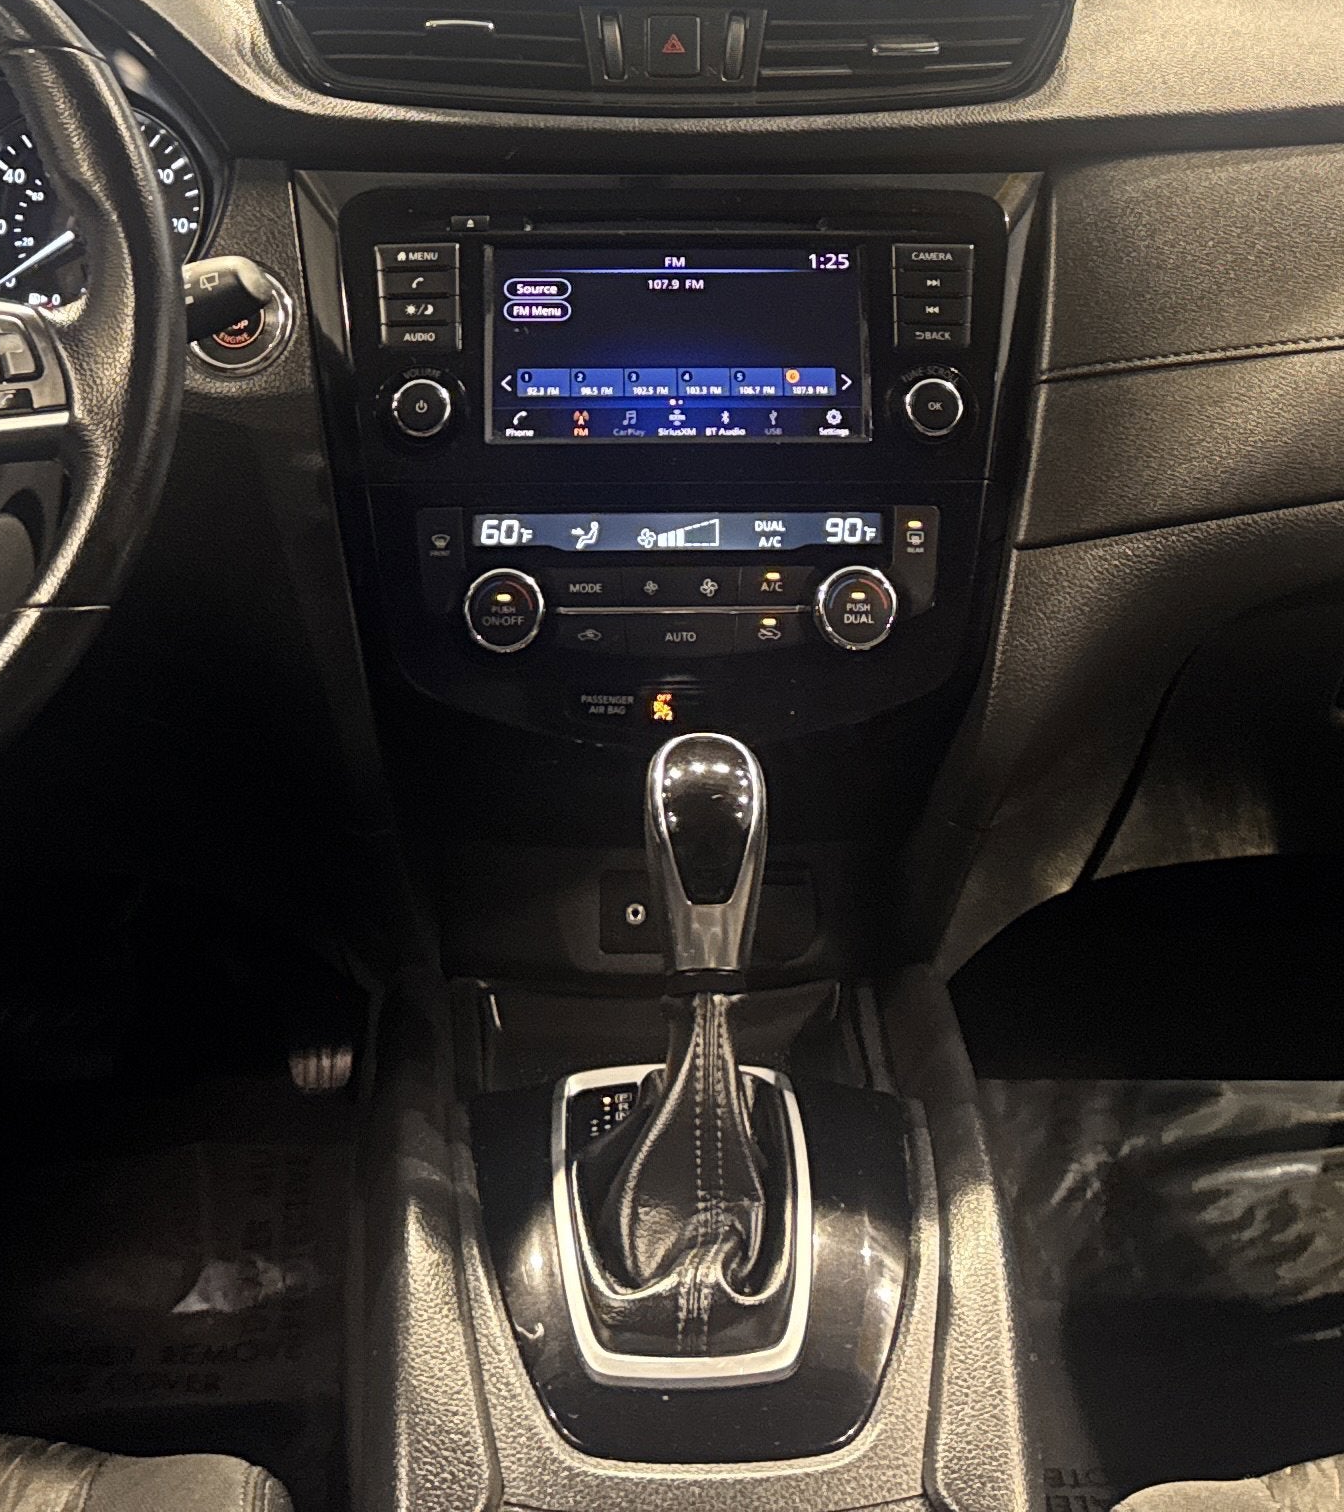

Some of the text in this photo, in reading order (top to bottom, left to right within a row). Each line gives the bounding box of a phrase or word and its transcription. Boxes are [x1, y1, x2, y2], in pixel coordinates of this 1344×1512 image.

[2, 167, 27, 184] 40
[408, 252, 439, 262] MENU
[808, 253, 850, 270] 1:25
[911, 252, 953, 261] CAMERA
[664, 256, 686, 268] FM
[516, 283, 558, 295] Source
[647, 279, 705, 290] 107.9 FM
[512, 305, 562, 317] FM Menu
[218, 331, 251, 345] ENGINE
[403, 332, 436, 342] AUDIO
[925, 331, 952, 341] BACK
[547, 386, 560, 396] FM
[600, 386, 613, 396] FM
[656, 386, 669, 396] FM
[709, 386, 722, 396] FM
[762, 386, 775, 396] FM
[816, 386, 828, 396] FM
[927, 401, 944, 411] OK
[505, 428, 535, 438] Phone
[573, 428, 589, 437] FM
[612, 428, 647, 438] CarPlay
[657, 427, 697, 437] SiriusXM
[705, 427, 747, 437] BT Audio
[764, 427, 783, 436] USB
[818, 427, 850, 438] Settings
[754, 520, 786, 533] DUAL
[758, 536, 782, 548] A/C
[569, 583, 604, 594] MODE
[760, 581, 784, 592] A/C
[490, 605, 517, 615] PUSH
[845, 602, 872, 613] PUSH
[843, 613, 876, 625] DUAL
[664, 631, 698, 643] AUTO
[580, 694, 635, 705] PASSENGER
[588, 705, 627, 715] AIR BAG
